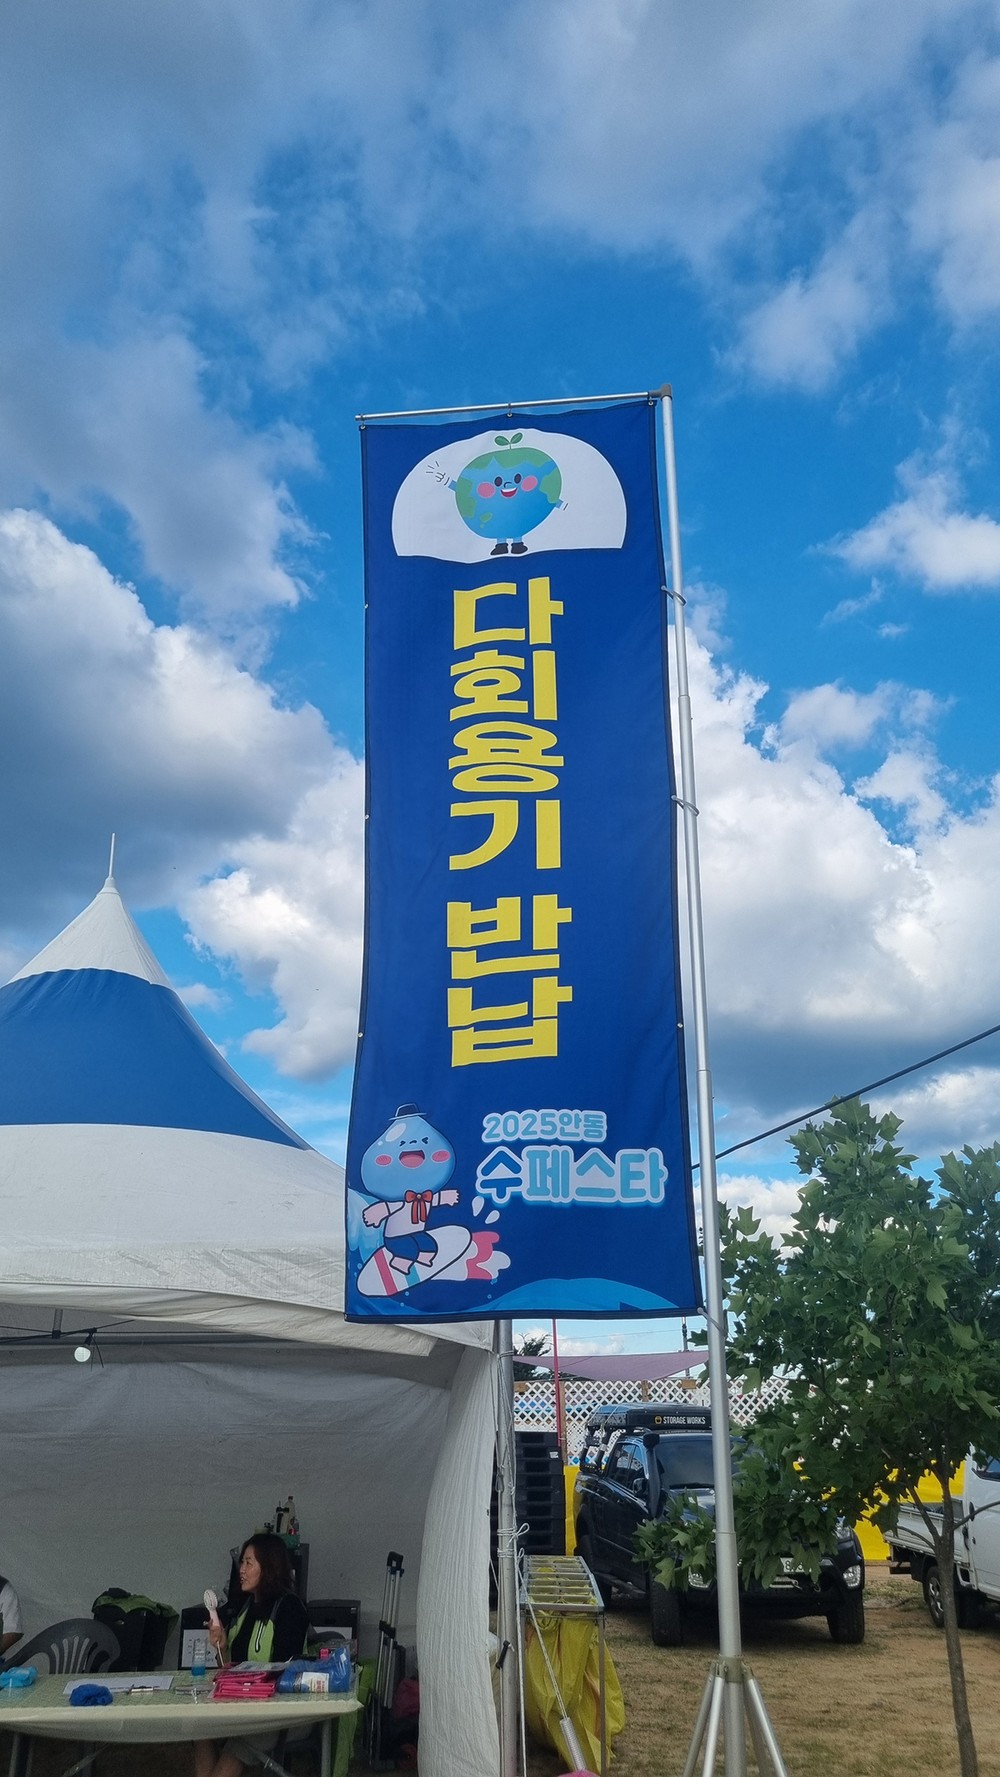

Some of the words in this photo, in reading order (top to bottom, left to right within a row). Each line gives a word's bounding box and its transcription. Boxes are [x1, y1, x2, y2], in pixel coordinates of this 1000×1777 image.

[448, 576, 564, 871] 다회용기
[447, 894, 572, 1067] 반납
[483, 1110, 606, 1142] 2025안동
[477, 1147, 666, 1202] 수페스타
[662, 1416, 686, 1425] STORAGE
[686, 1416, 706, 1425] WORKS
